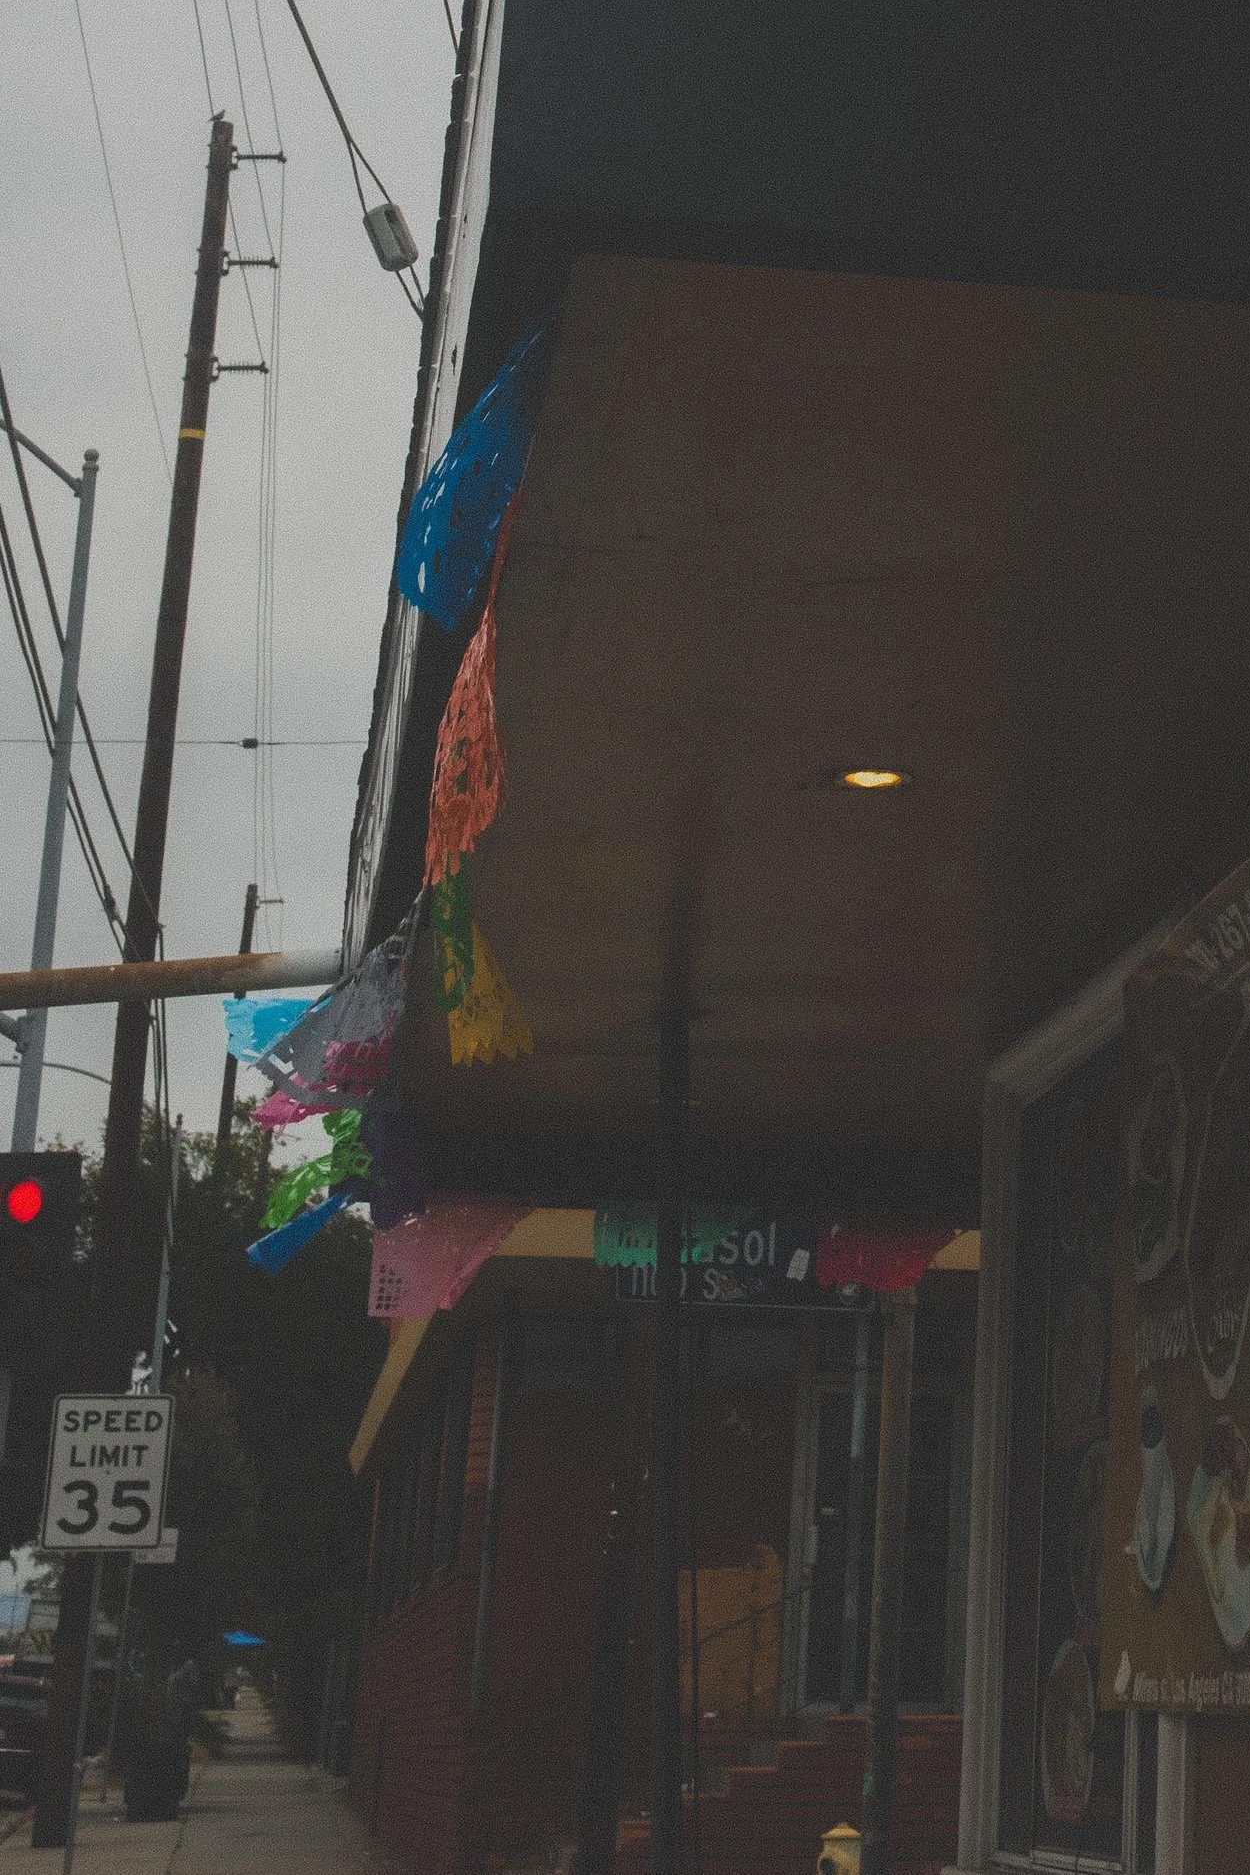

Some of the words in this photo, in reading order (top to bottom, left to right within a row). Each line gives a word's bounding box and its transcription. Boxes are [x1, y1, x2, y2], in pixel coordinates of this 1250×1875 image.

[63, 1410, 163, 1433] SPEED
[70, 1445, 149, 1467] LIMIT
[56, 1480, 151, 1535] 35
